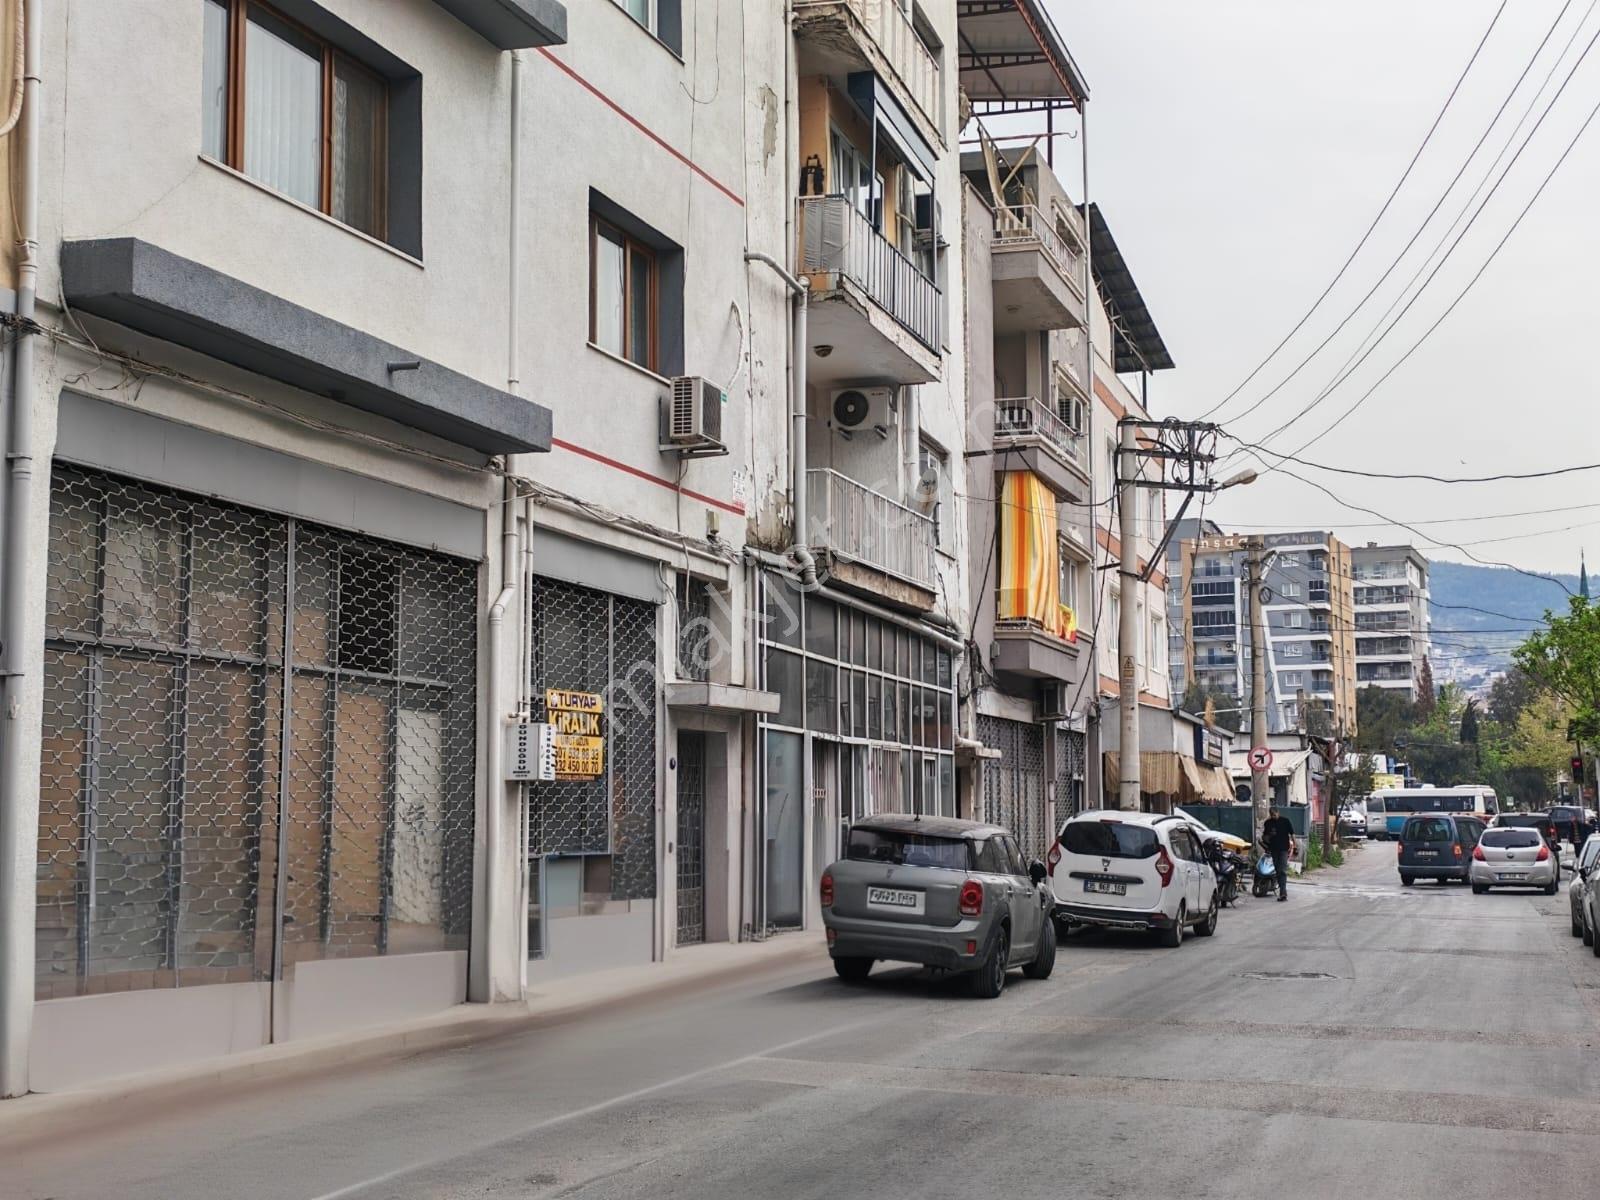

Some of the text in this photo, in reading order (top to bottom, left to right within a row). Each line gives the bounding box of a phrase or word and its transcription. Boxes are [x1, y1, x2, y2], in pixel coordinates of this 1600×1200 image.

[558, 692, 597, 708] TURYAP
[568, 760, 580, 772] 450
[591, 761, 599, 773] 70
